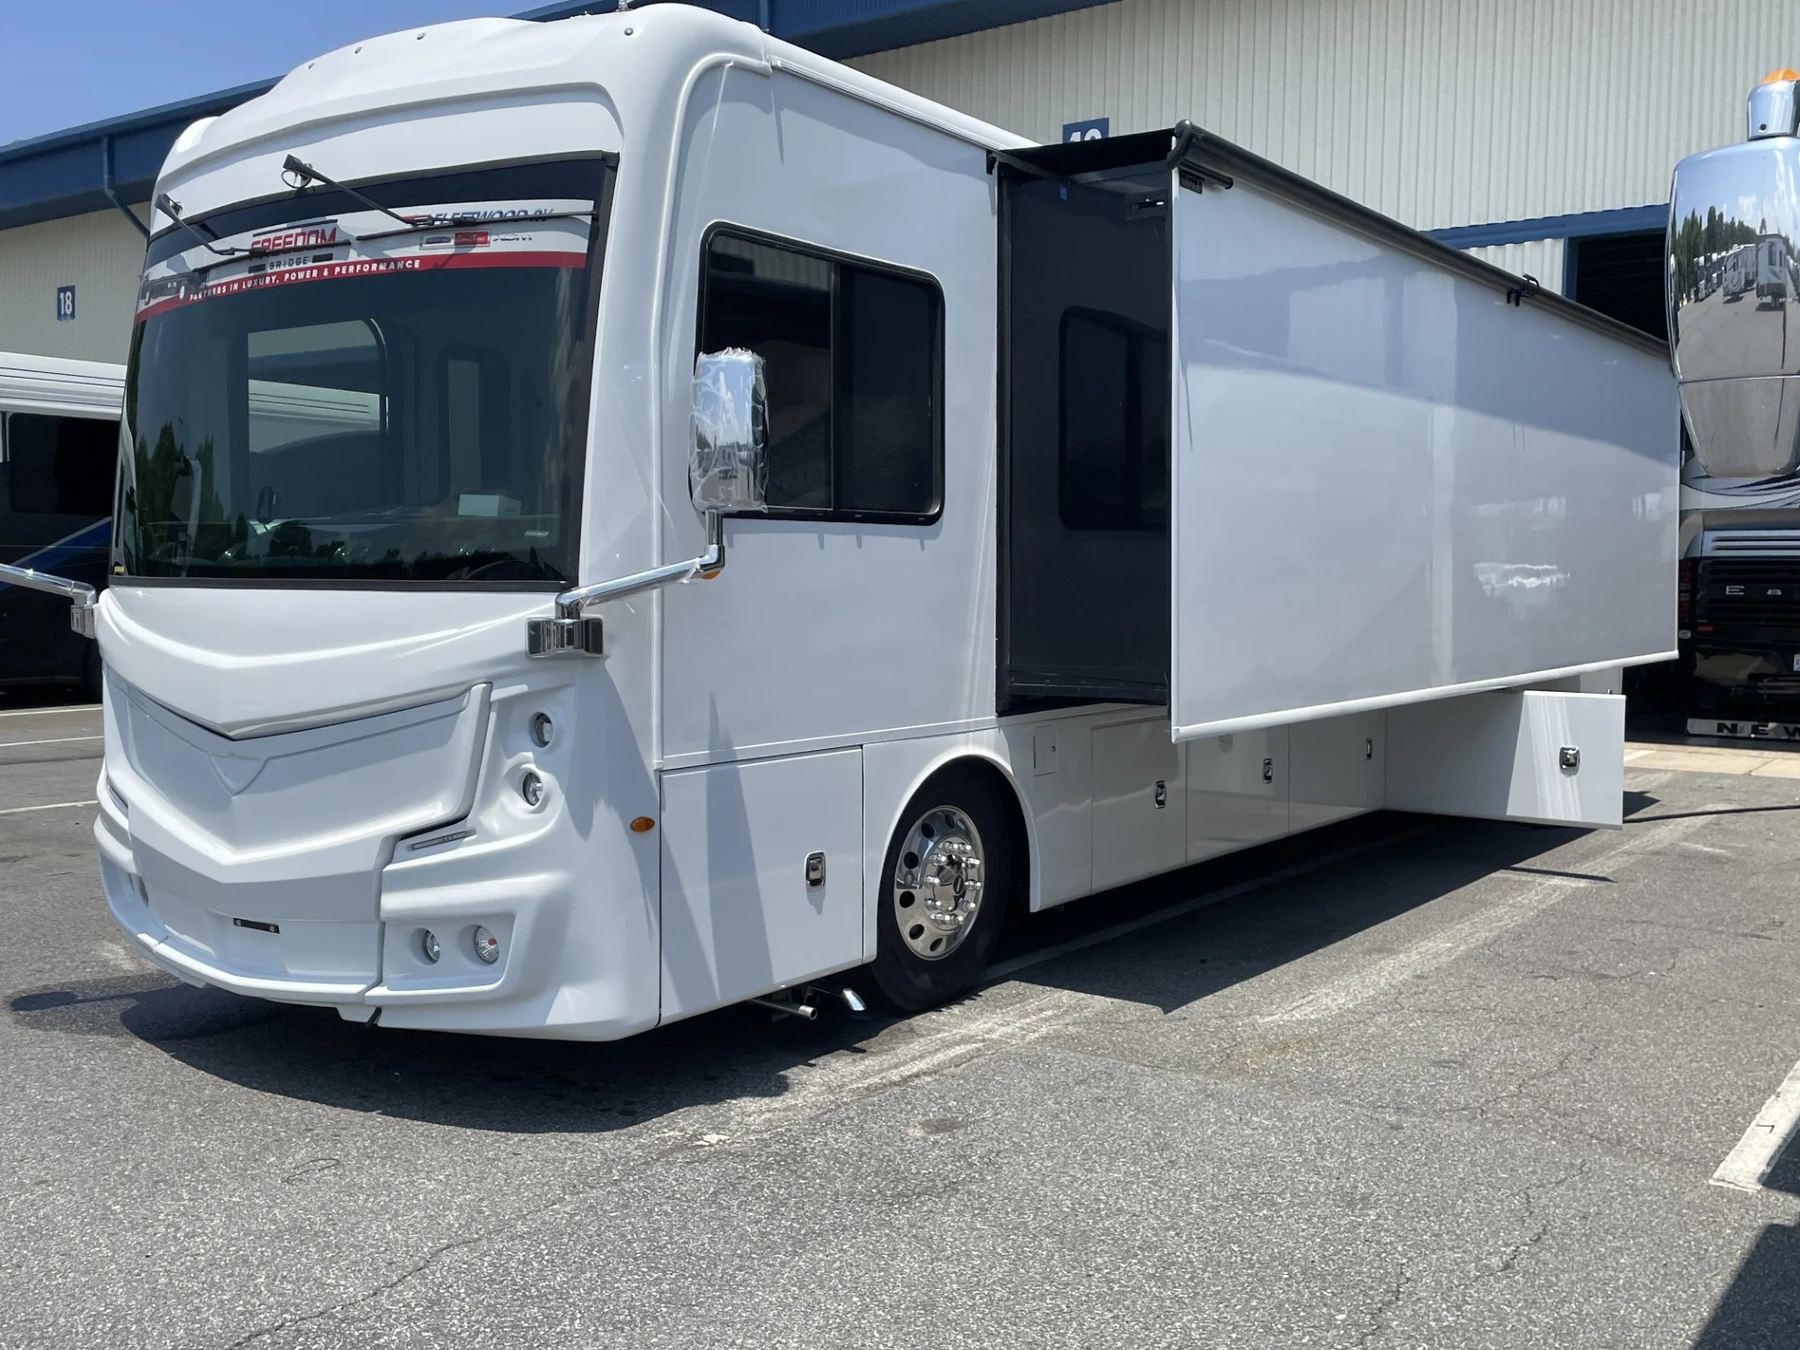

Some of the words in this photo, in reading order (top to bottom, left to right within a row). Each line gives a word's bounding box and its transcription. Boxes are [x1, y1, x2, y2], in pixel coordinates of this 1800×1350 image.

[251, 227, 337, 257] FREEDOM
[269, 257, 308, 270] BRIDGE
[190, 285, 227, 301] PARTNERS
[229, 282, 239, 292] IN
[242, 275, 280, 289] LUXURY,
[284, 269, 318, 281] POWER
[323, 268, 329, 276] &
[335, 260, 420, 275] PERFORMANCE
[60, 291, 73, 315] 18
